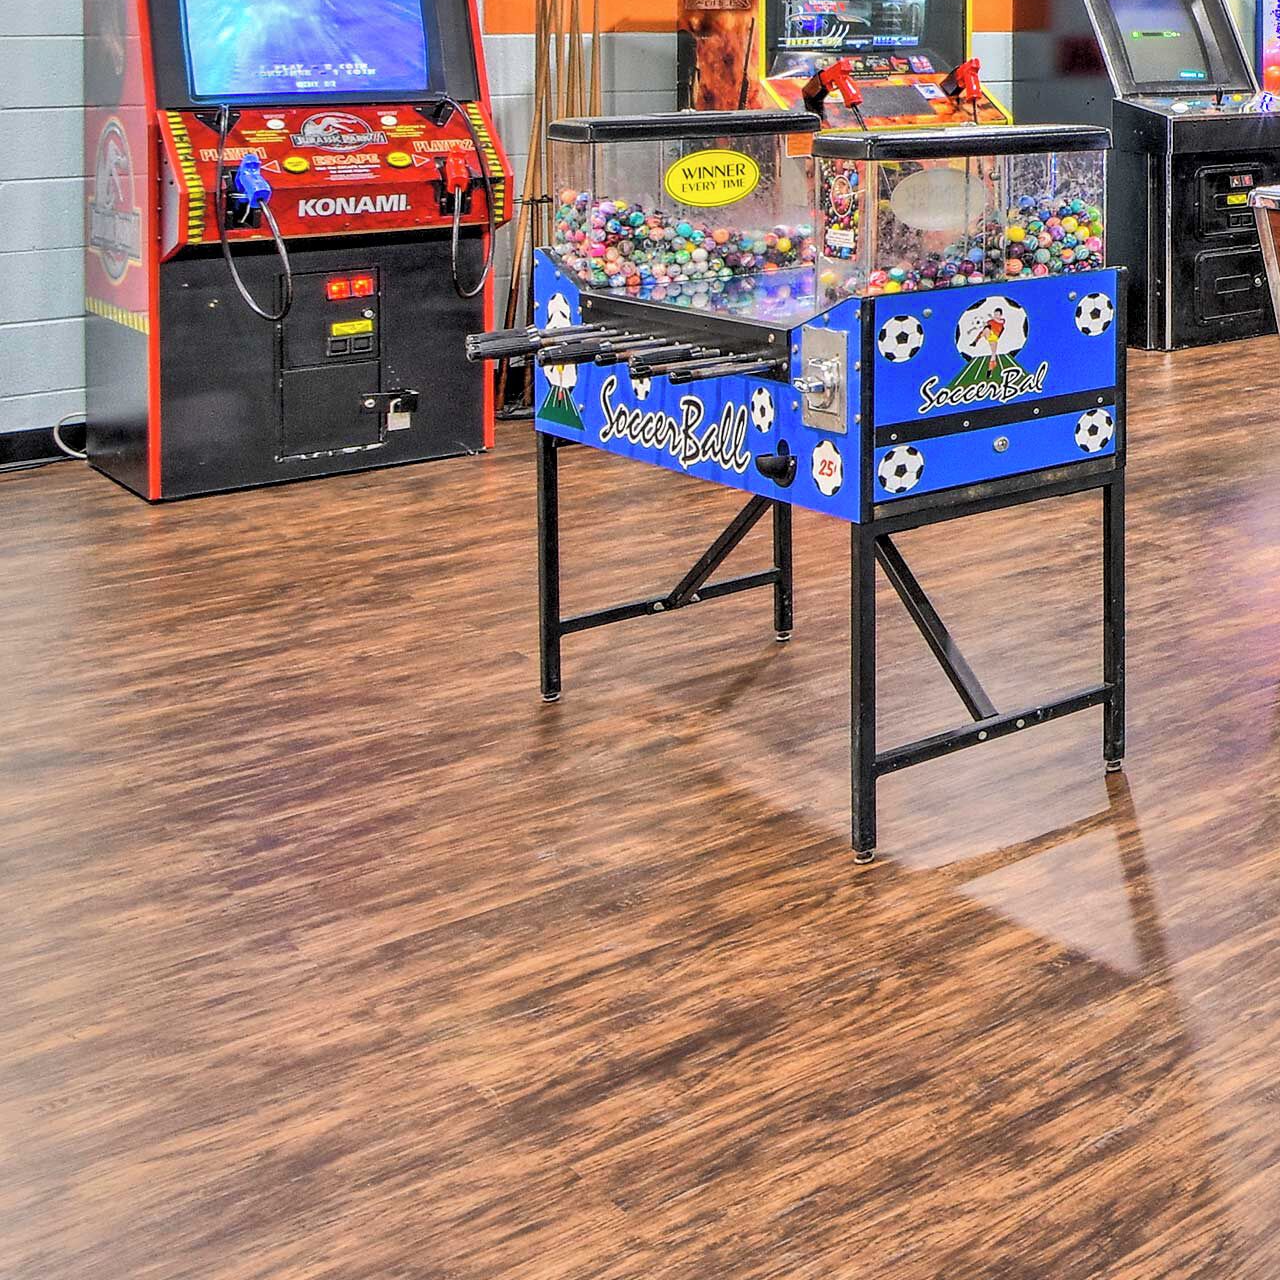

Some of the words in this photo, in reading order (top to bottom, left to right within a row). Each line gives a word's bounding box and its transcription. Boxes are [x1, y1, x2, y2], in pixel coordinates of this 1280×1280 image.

[312, 153, 381, 167] ESCAPE
[681, 162, 746, 180] WINNER
[681, 181, 717, 193] EVERY
[722, 178, 744, 189] TIME
[298, 194, 409, 218] KONAMI
[600, 375, 751, 474] SoccerBall
